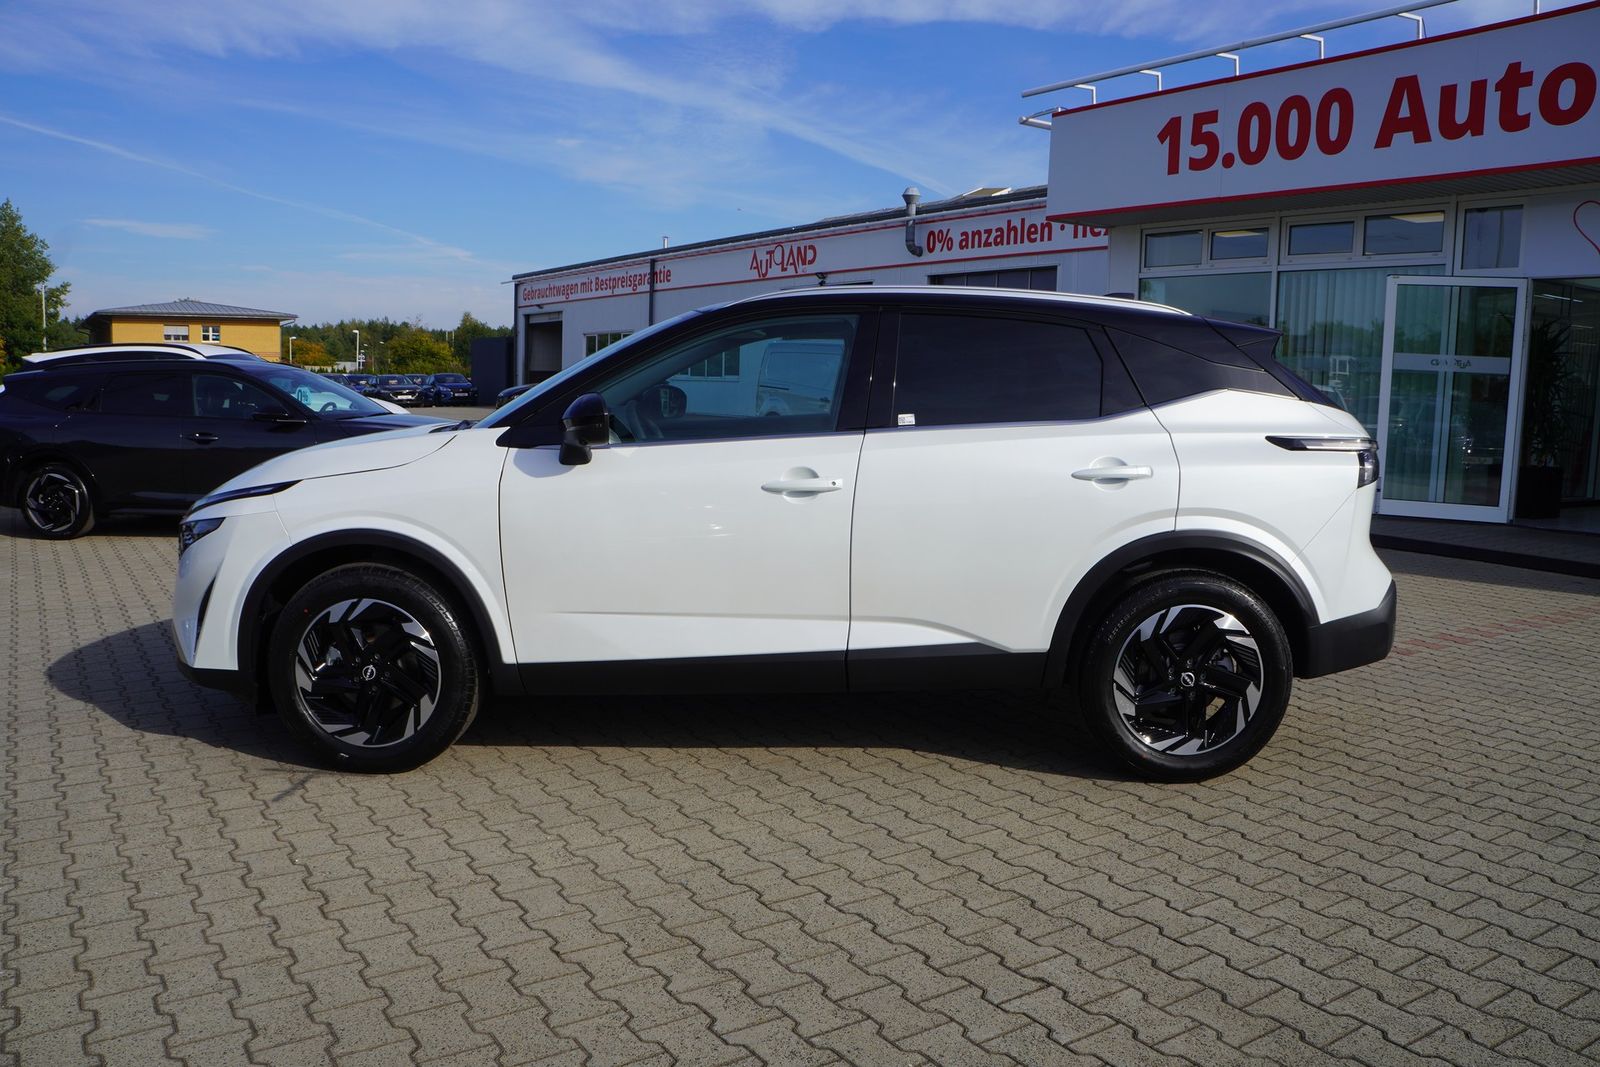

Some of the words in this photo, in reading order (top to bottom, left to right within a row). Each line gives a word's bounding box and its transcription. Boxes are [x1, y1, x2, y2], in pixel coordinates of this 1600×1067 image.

[1156, 87, 1354, 176] 15.000
[1374, 61, 1598, 150] Auto
[926, 228, 954, 254] 0%
[958, 217, 1053, 250] anzahlen
[749, 244, 817, 278] AUTOLAND
[522, 282, 579, 301] Gebrauchtwagen
[580, 277, 593, 294] mit
[594, 265, 672, 294] Bestpreisgarantie
